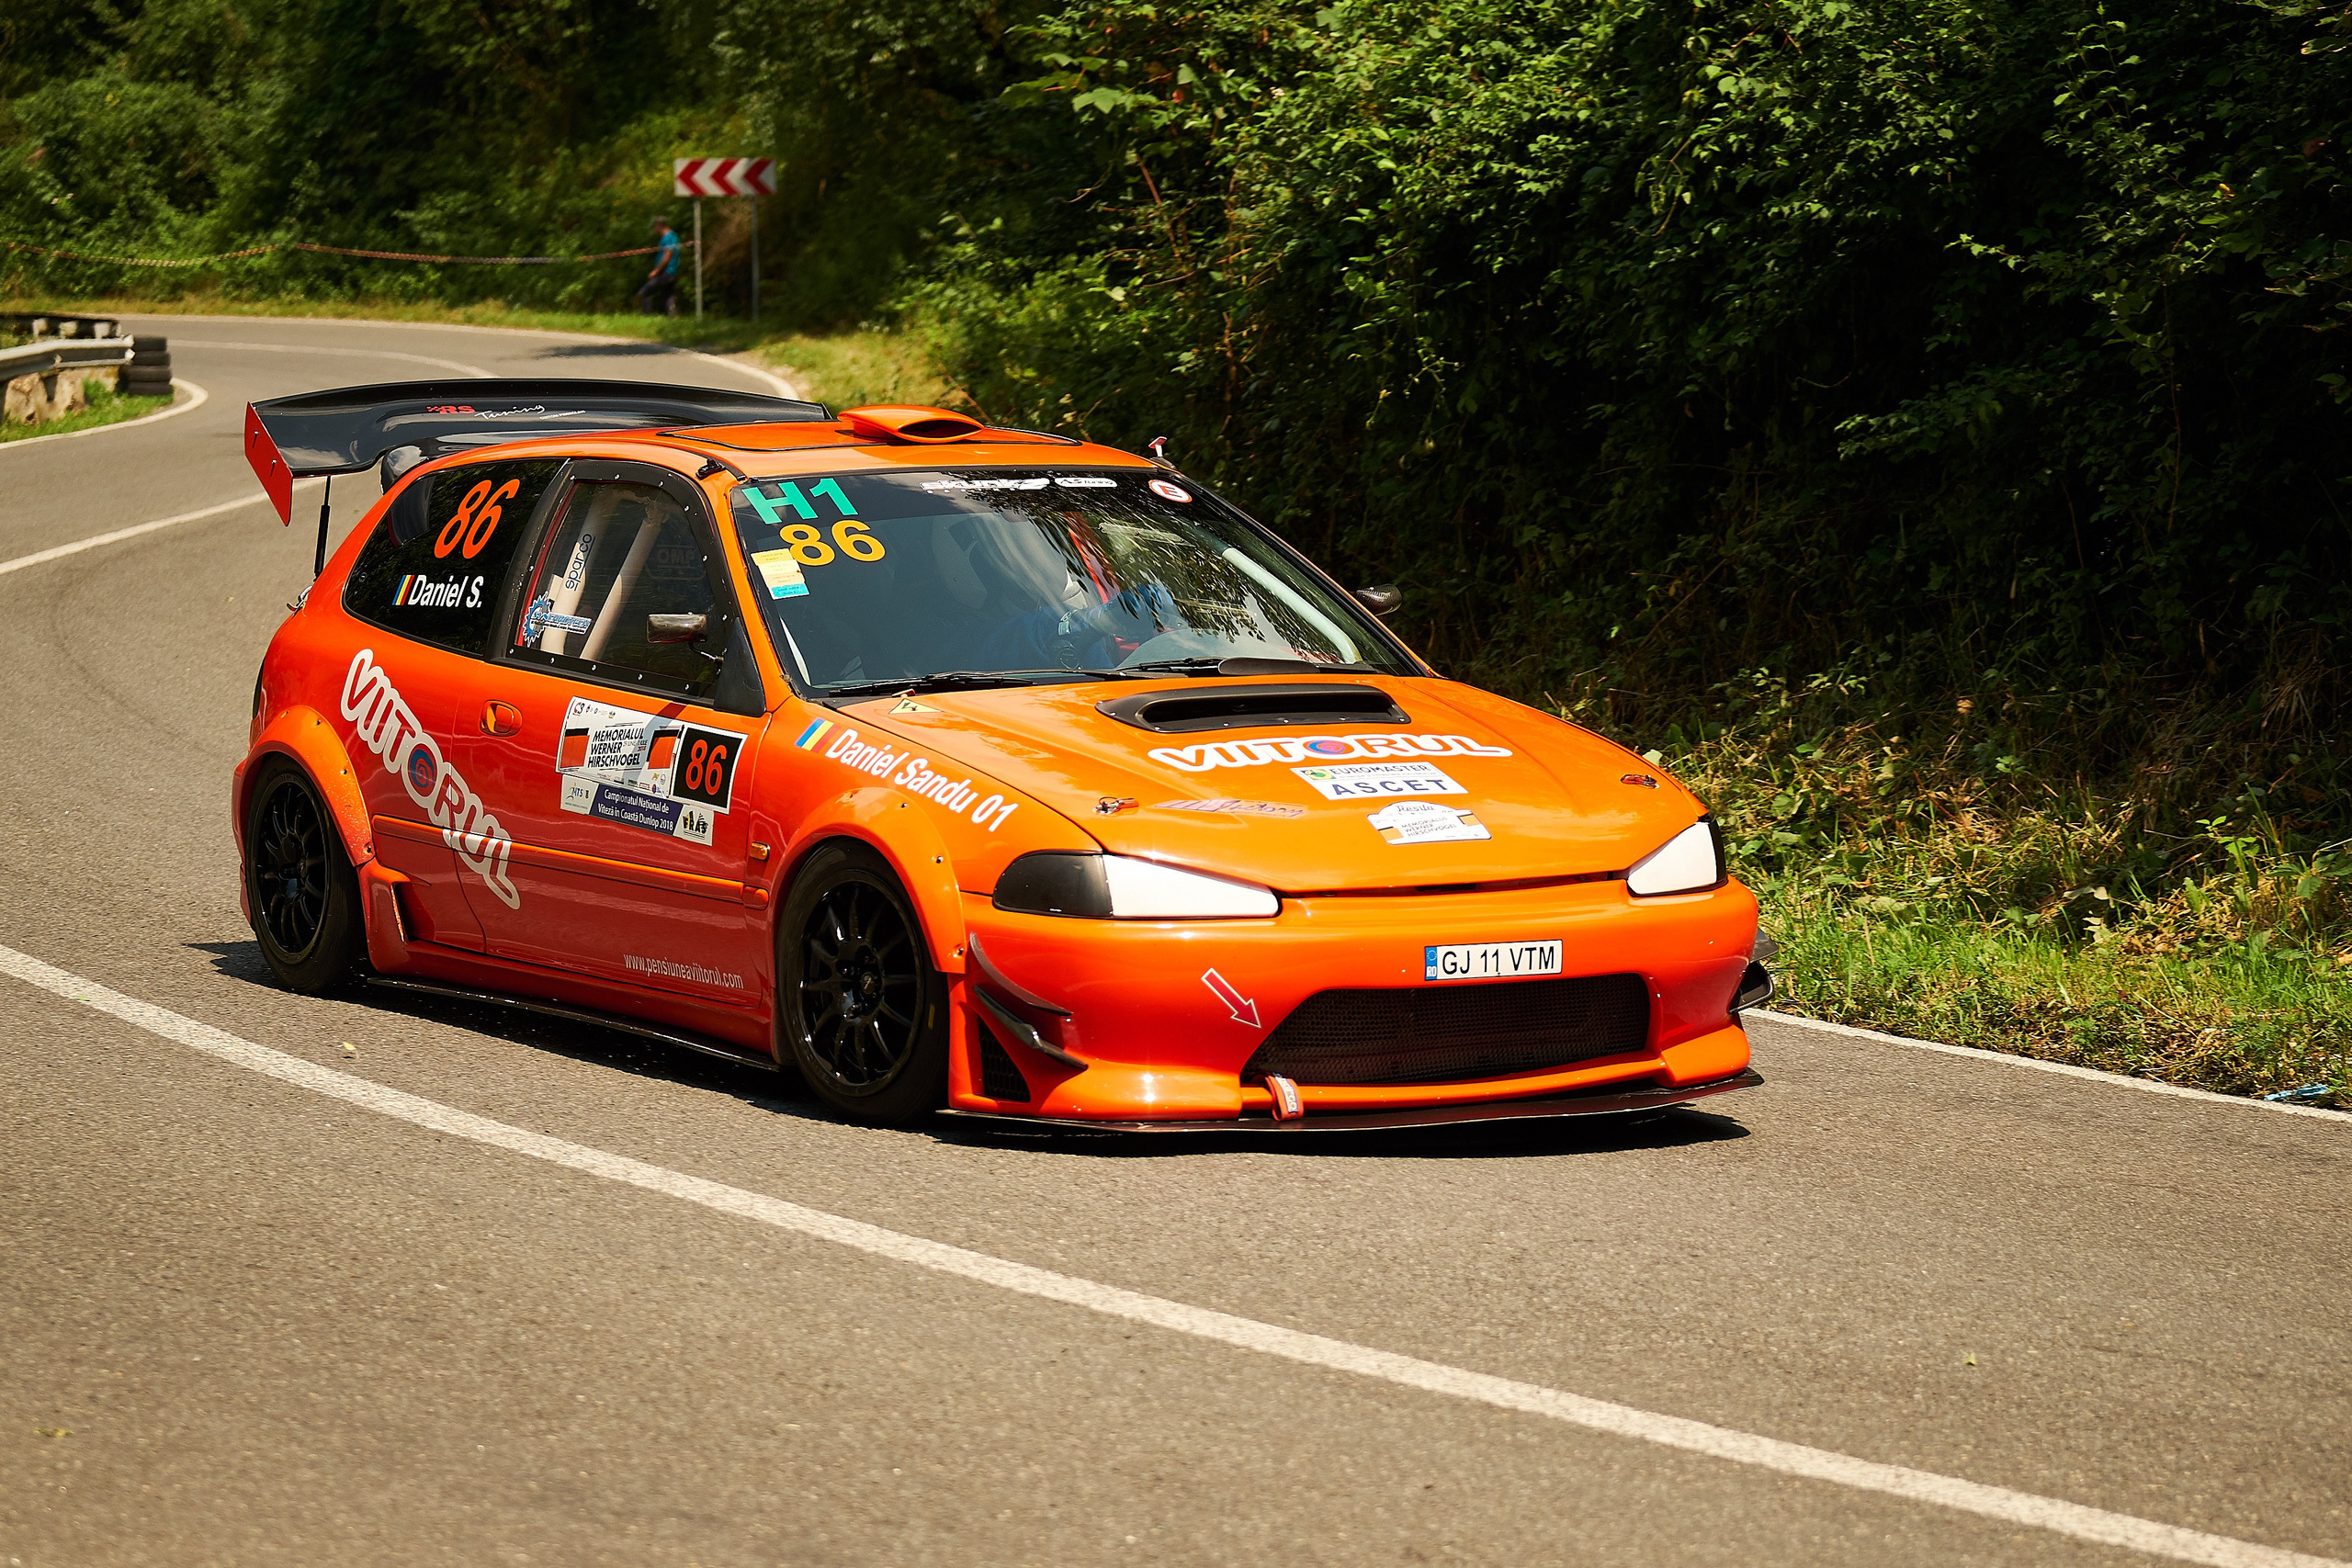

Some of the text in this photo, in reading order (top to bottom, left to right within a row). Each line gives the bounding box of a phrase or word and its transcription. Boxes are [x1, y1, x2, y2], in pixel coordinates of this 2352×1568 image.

[474, 404, 546, 420] Tuning
[741, 478, 858, 525] H1
[1158, 484, 1182, 499] E
[434, 479, 520, 559] 86
[779, 519, 886, 566] 86
[565, 533, 594, 592] sparco
[407, 574, 484, 608] Daniel S.
[593, 728, 645, 742] MEMORIALUL
[591, 741, 623, 755] WERNER
[1147, 733, 1513, 772] VIITORUL
[587, 752, 640, 768] HIRSCHVOGEL
[685, 739, 728, 795] 86
[1329, 764, 1431, 775] EUROMASTER
[340, 649, 521, 909] VIITORUL
[825, 728, 1019, 832] Daniel Sandu 01
[1331, 779, 1449, 795] ASCET
[604, 788, 638, 807] Campionatul
[662, 800, 670, 814] de
[639, 813, 659, 829] Dunlop
[660, 818, 674, 831] 2018
[1401, 817, 1448, 829] MEMORIALUL
[1405, 823, 1434, 832] WERNER
[1408, 823, 1457, 837] HIRSCHVOGEL
[623, 953, 744, 989] www.pensiuneaviitorul.com
[1426, 965, 1437, 977] RO
[1442, 945, 1555, 976] GJ 11 VTM
